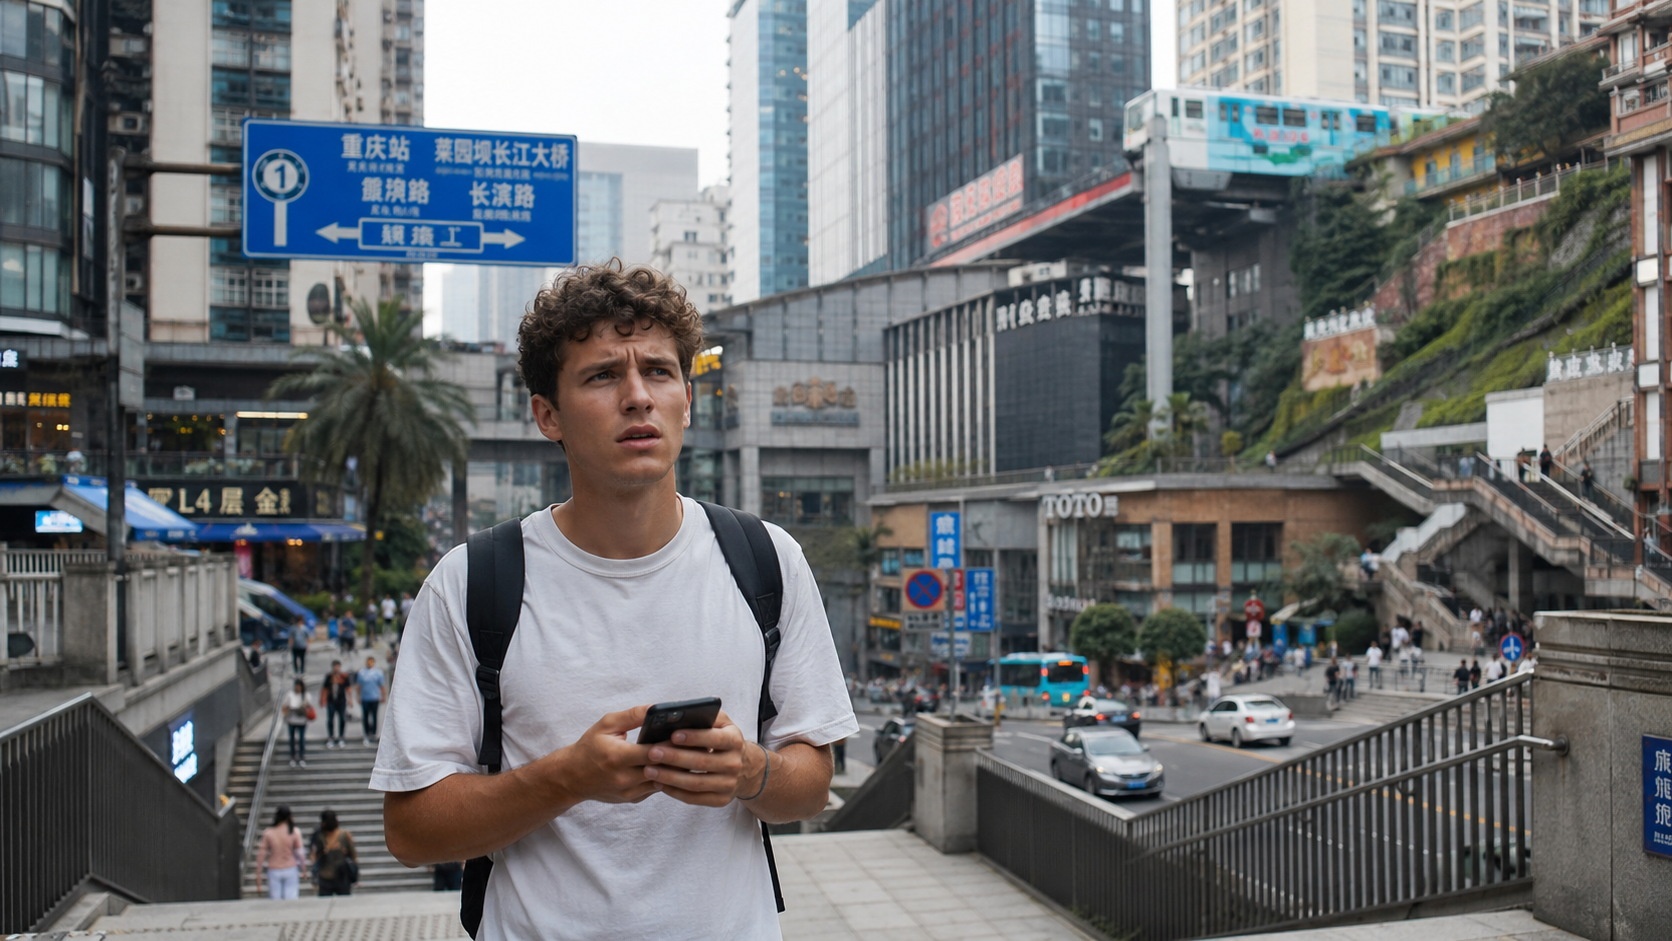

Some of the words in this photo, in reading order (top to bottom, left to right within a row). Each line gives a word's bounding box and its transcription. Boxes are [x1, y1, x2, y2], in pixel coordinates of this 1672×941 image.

[341, 133, 411, 162] 重庆站
[434, 137, 570, 169] 菜园坝长江大桥
[275, 163, 286, 189] 1
[1042, 492, 1103, 519] TOTO
